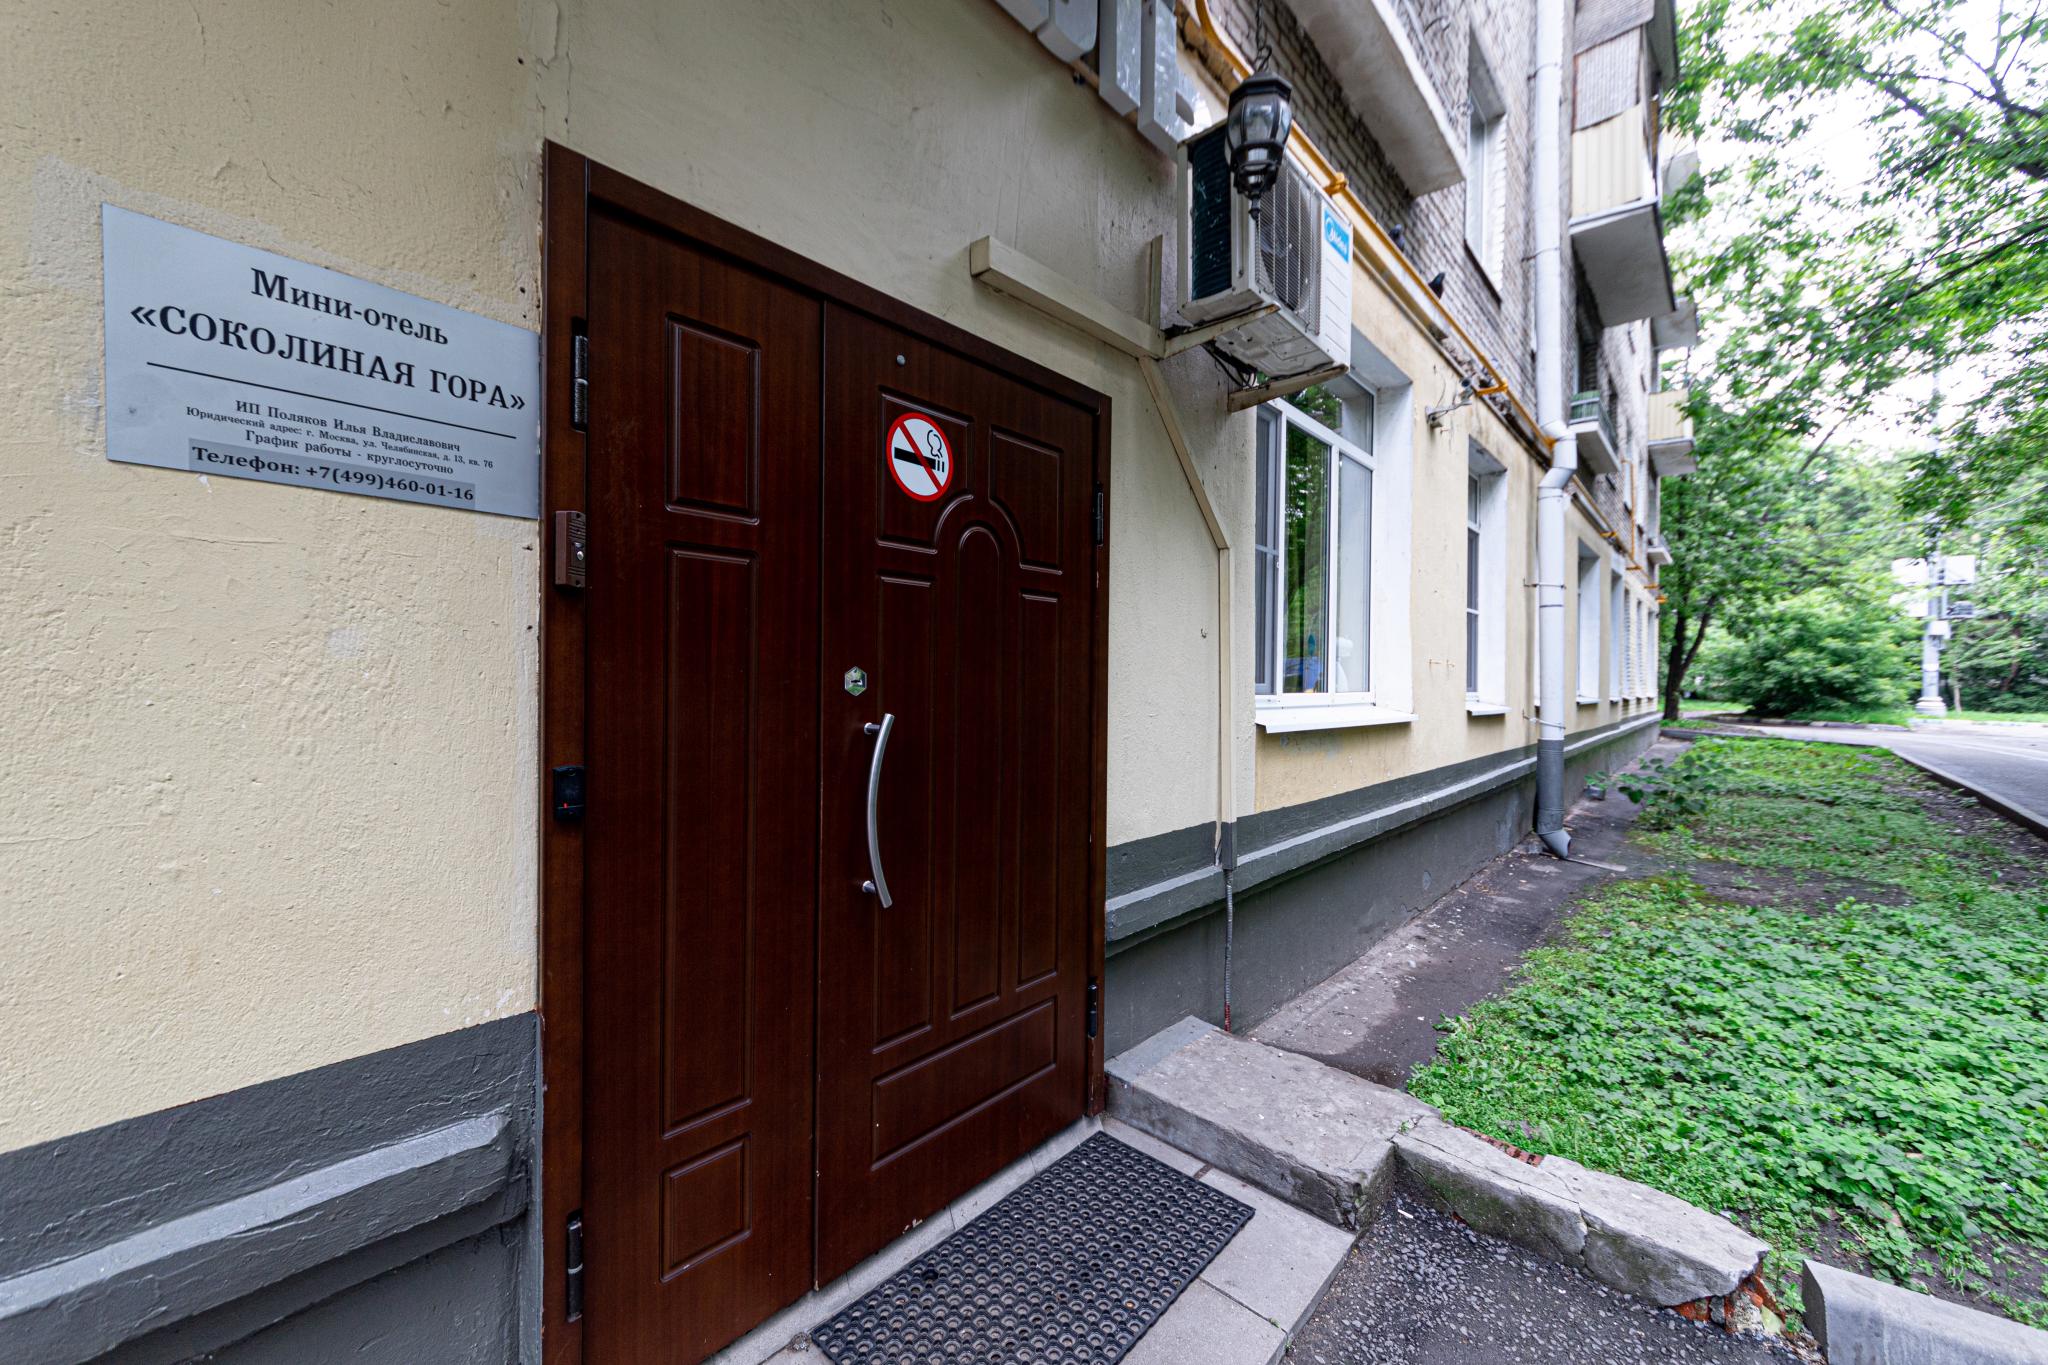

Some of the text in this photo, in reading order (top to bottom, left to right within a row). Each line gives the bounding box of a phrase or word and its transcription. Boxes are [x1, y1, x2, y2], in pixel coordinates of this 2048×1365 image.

[250, 267, 448, 345] Мини-отель
[130, 305, 525, 411] «СОКОЛИНАЯ ГОРА»
[186, 406, 265, 429] Юридический
[270, 423, 302, 436] адрес:
[319, 430, 358, 445] Москва,
[362, 439, 377, 448] ул.
[381, 440, 440, 460] Челябинская,
[443, 454, 450, 462] д.
[454, 454, 466, 464] 13,
[469, 458, 480, 466] кв.
[483, 459, 494, 469] 76
[235, 400, 460, 452] ИП Поляков Илья Владиславович
[245, 429, 298, 449] График
[304, 442, 352, 458] работы
[367, 452, 454, 475] круглосуточно
[191, 446, 474, 500] Телефон: +7(499)460-01-16
